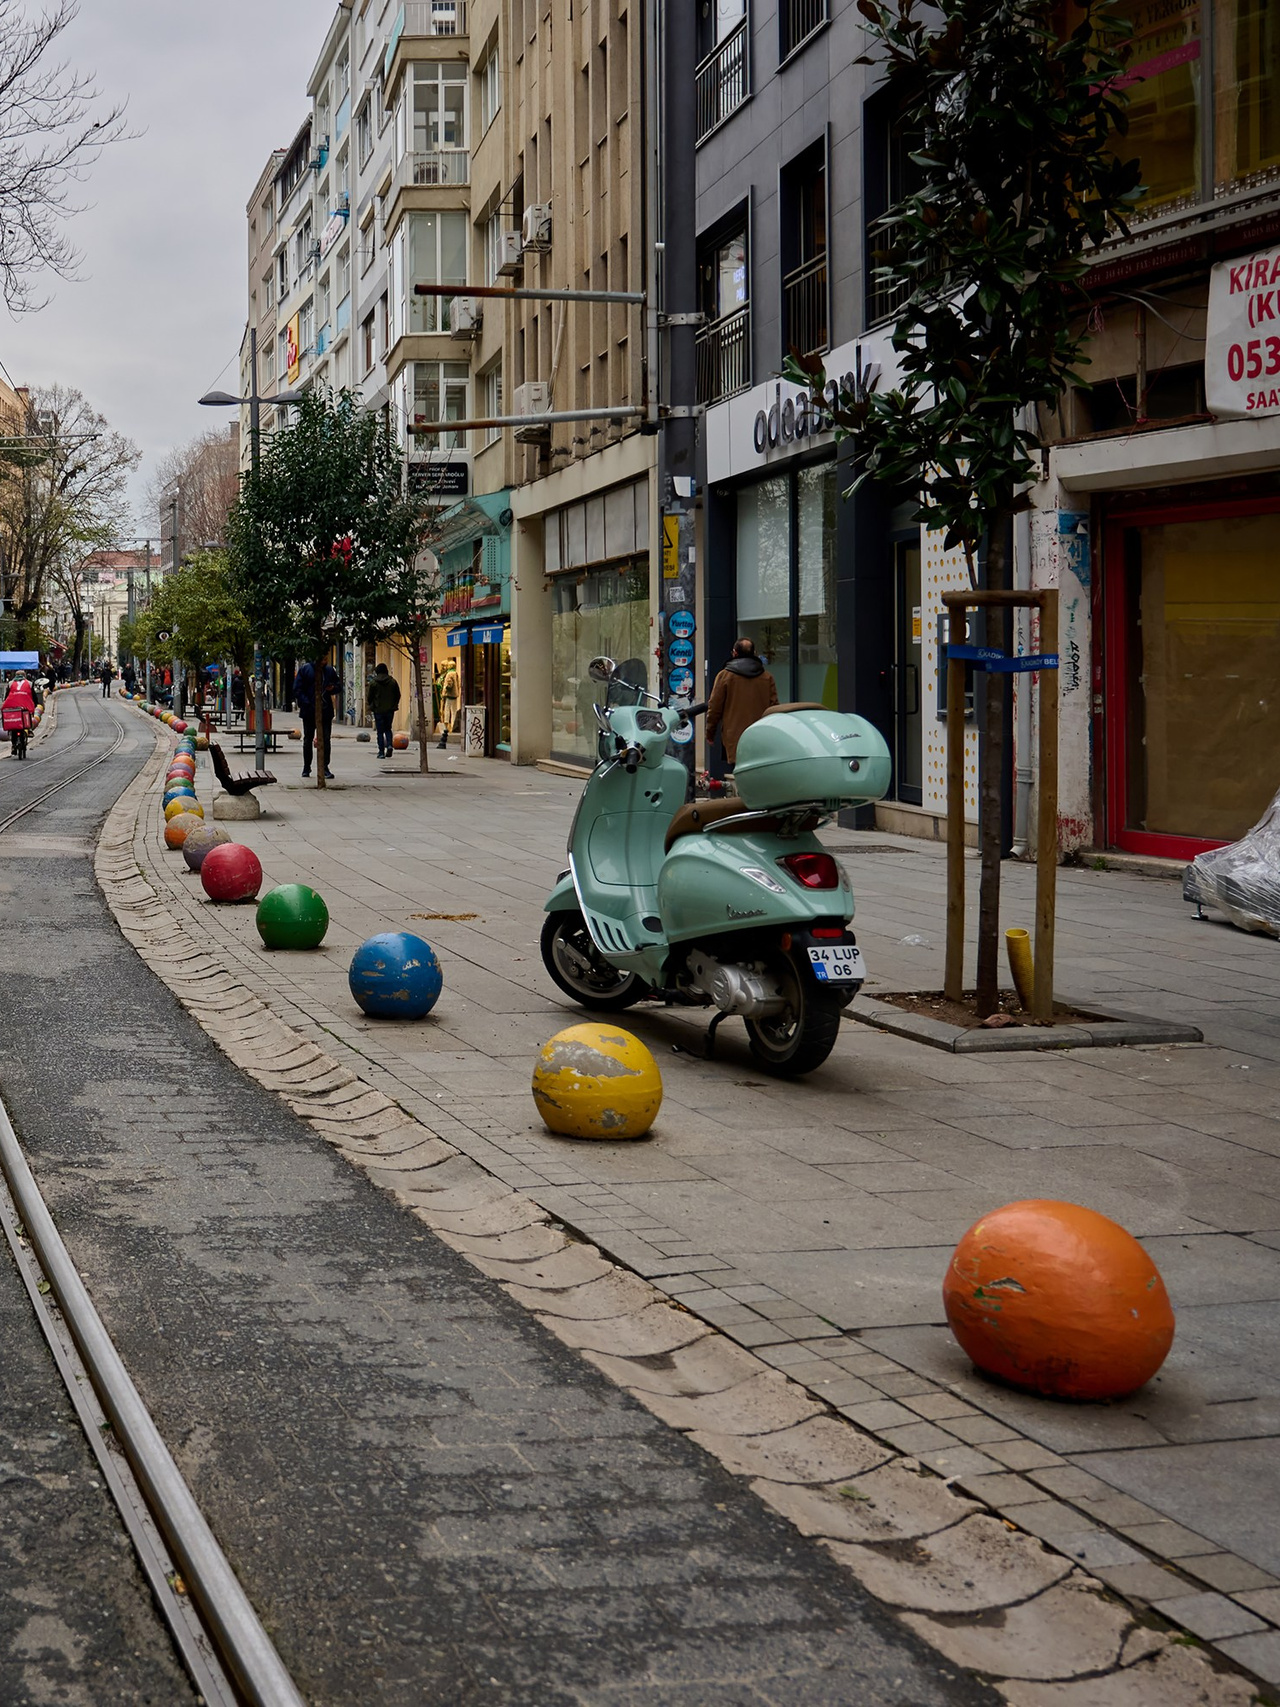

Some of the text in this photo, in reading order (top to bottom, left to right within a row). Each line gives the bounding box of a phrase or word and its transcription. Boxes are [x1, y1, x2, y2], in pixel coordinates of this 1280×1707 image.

[810, 948, 860, 962] 34 LUP
[816, 971, 827, 979] TR
[833, 964, 852, 976] 06
